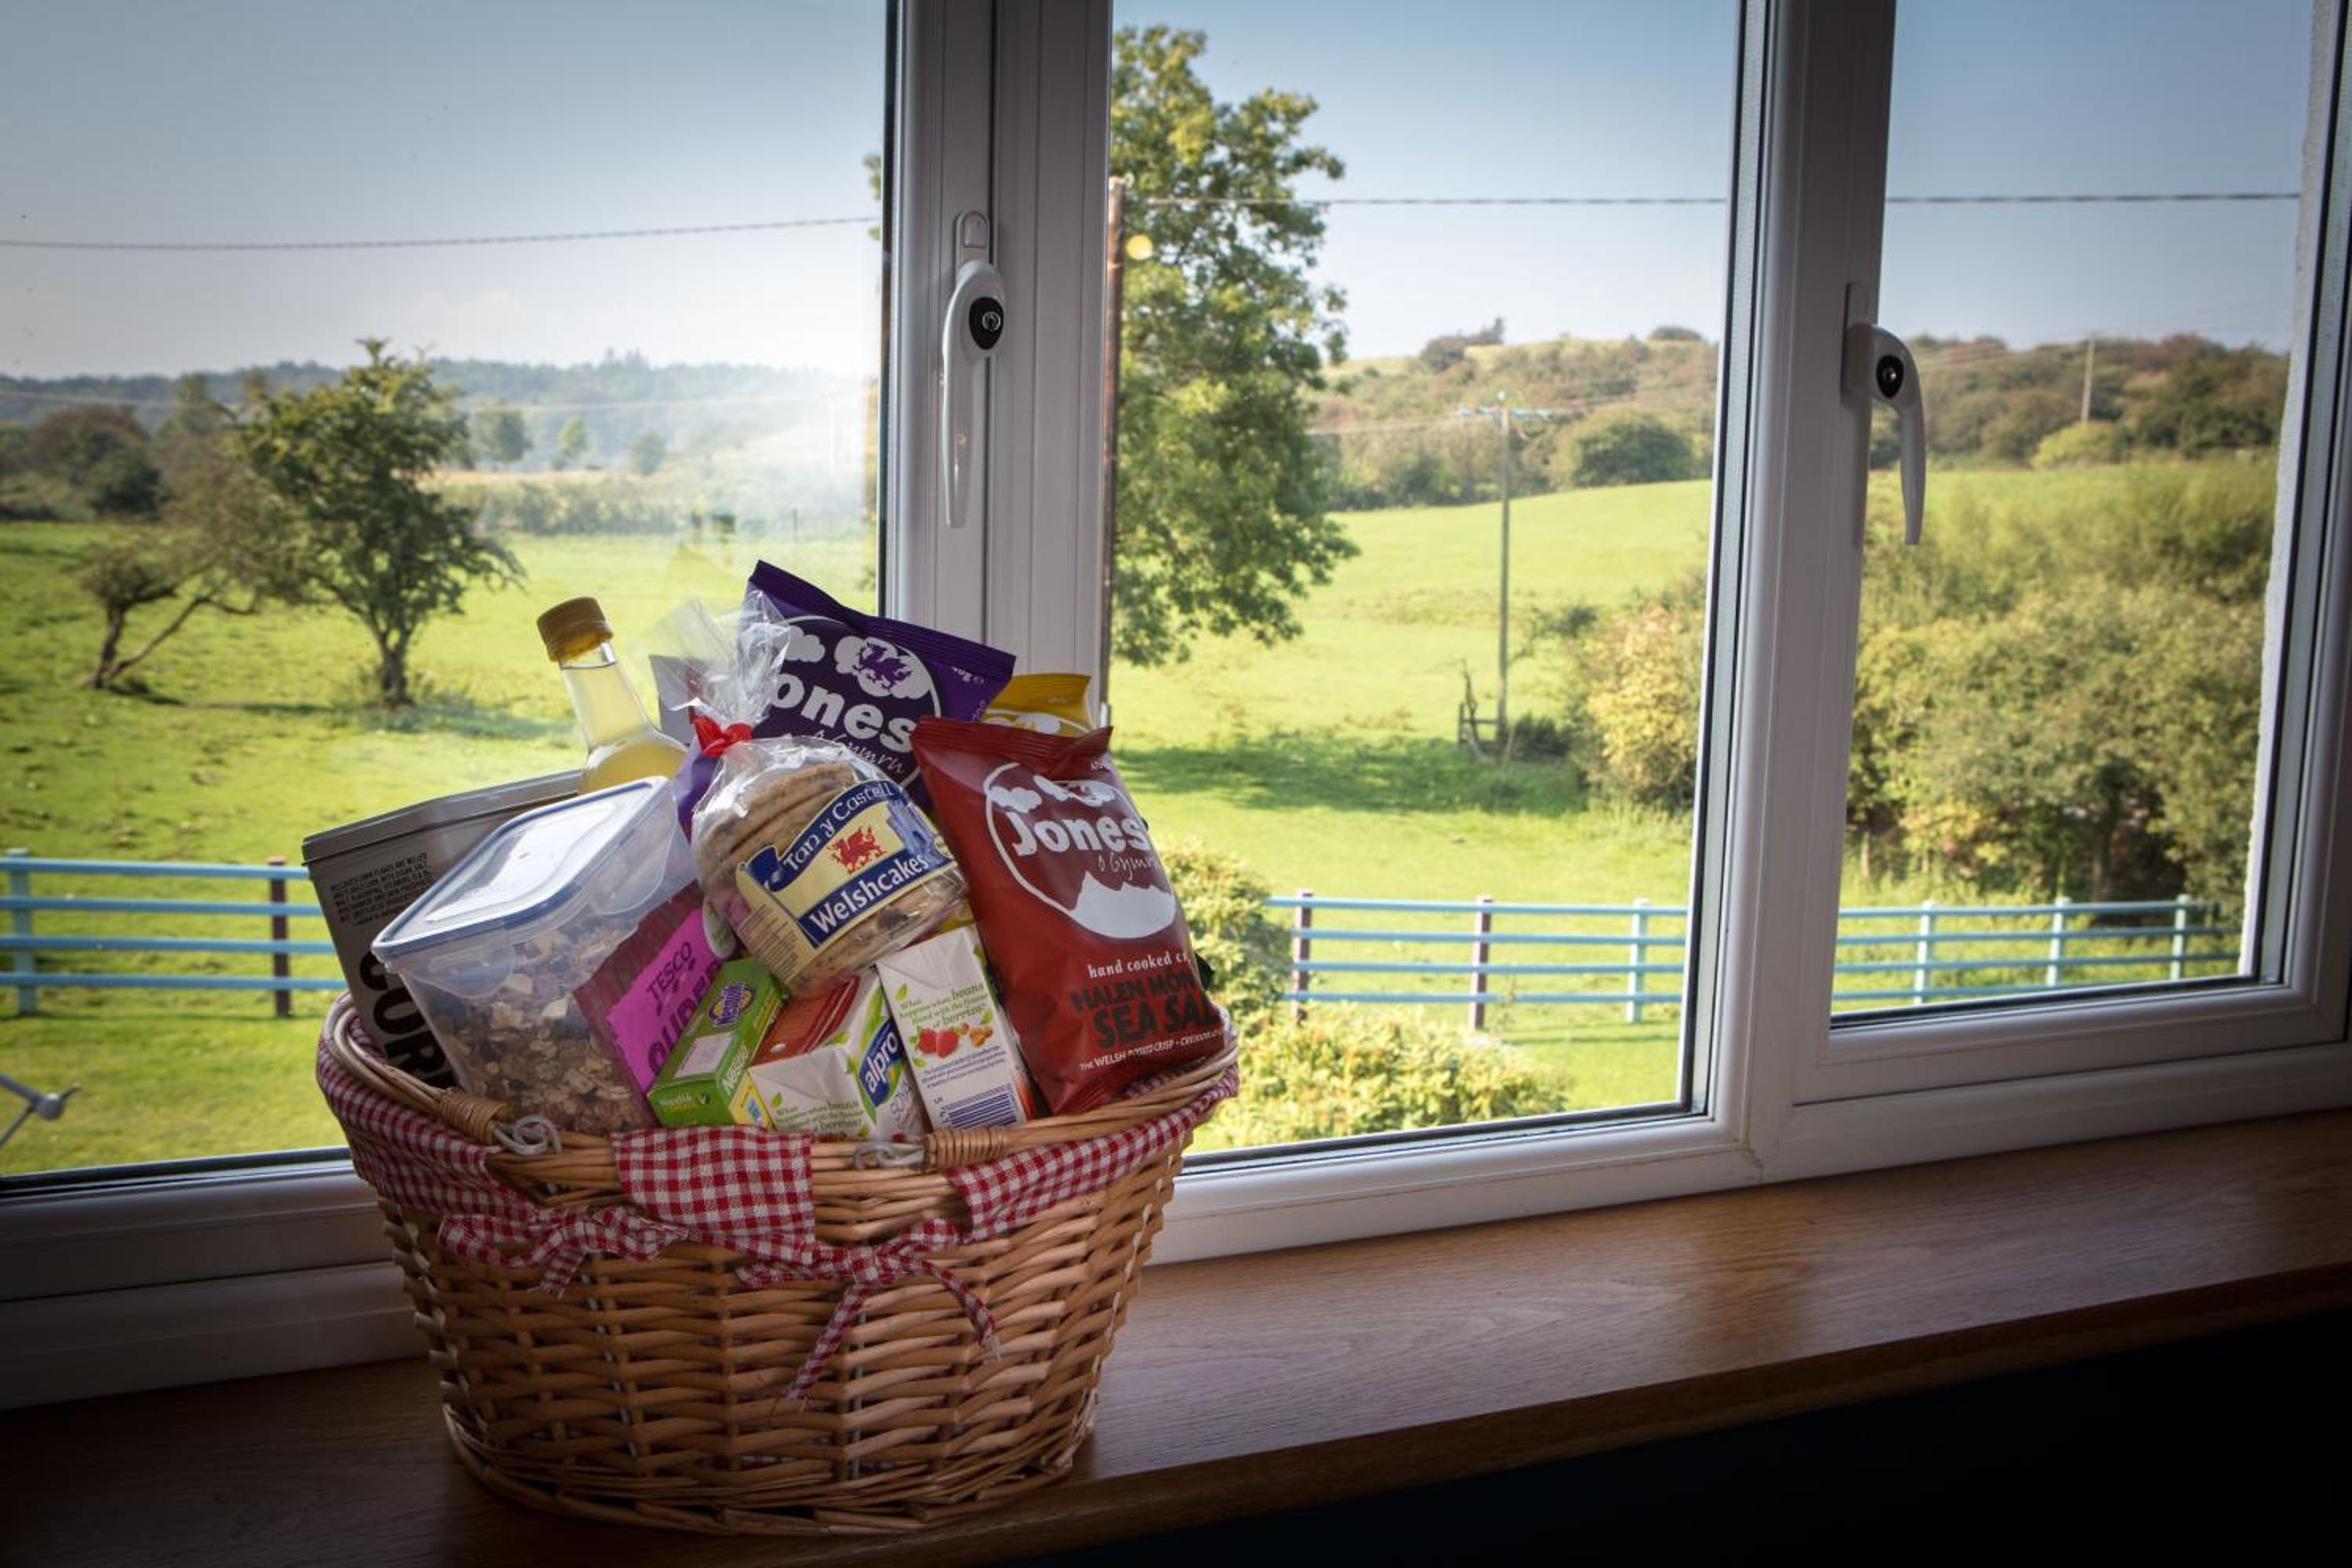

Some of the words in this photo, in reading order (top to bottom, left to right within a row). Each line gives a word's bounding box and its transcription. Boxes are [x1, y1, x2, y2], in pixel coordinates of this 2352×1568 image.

[772, 672, 916, 753] ones
[782, 834, 822, 871] Tan
[822, 818, 837, 837] y
[833, 782, 895, 822] Castell
[1005, 811, 1151, 856] Jones
[808, 853, 930, 935] Welshcakes
[645, 941, 692, 1002] TESCO
[1087, 959, 1123, 979] hand
[1127, 950, 1173, 971] cooked
[1093, 1001, 1159, 1049] SEA
[865, 1031, 898, 1094] alpro
[1094, 1051, 1127, 1069] WELSH
